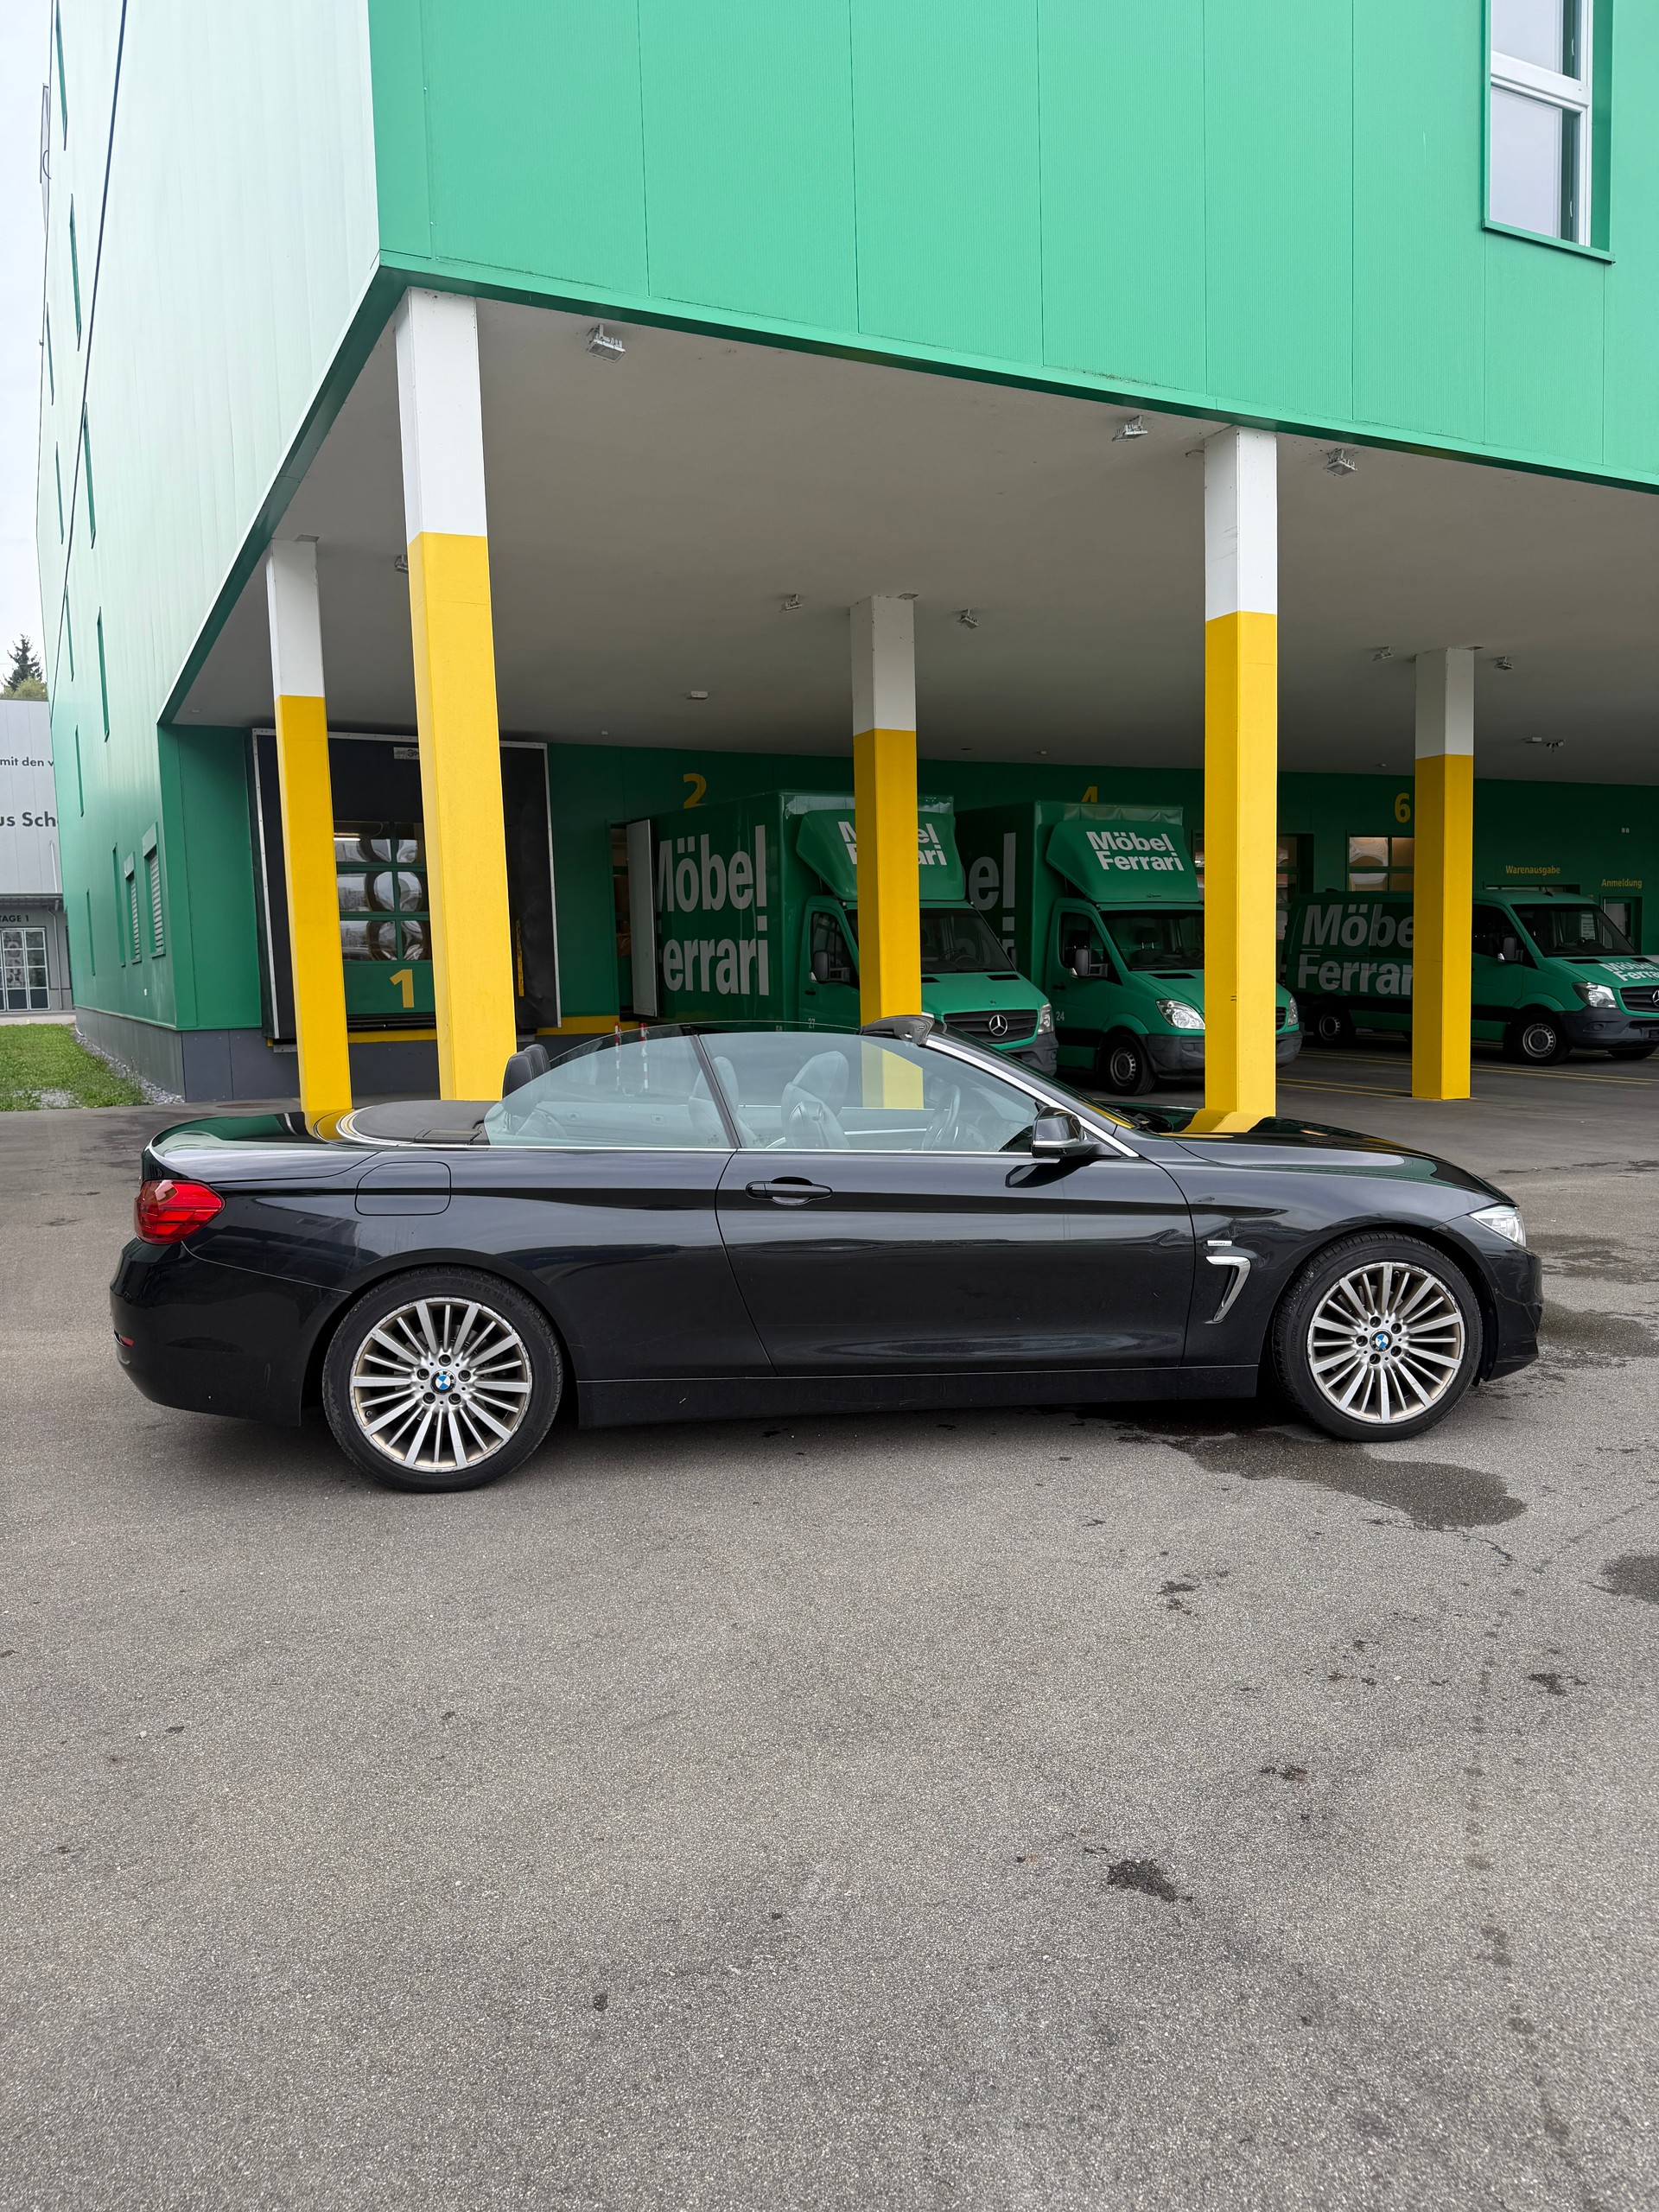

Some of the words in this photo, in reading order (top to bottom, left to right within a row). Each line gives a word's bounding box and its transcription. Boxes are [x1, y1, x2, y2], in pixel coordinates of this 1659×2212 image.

[22, 756, 44, 766] den
[683, 772, 707, 809] 2
[1394, 792, 1411, 823] 6
[22, 810, 58, 827] Sch
[1086, 831, 1175, 851] Möbel
[1096, 851, 1184, 871] Ferrari
[1506, 865, 1560, 875] Warenausgabe
[1601, 879, 1642, 888] Anmeldung
[1301, 904, 1414, 949] Möbe
[658, 915, 769, 995] errari
[1298, 949, 1414, 995] Ferrar
[390, 969, 415, 1008] 1
[808, 1018, 816, 1029] 27
[1056, 1011, 1065, 1021] 24
